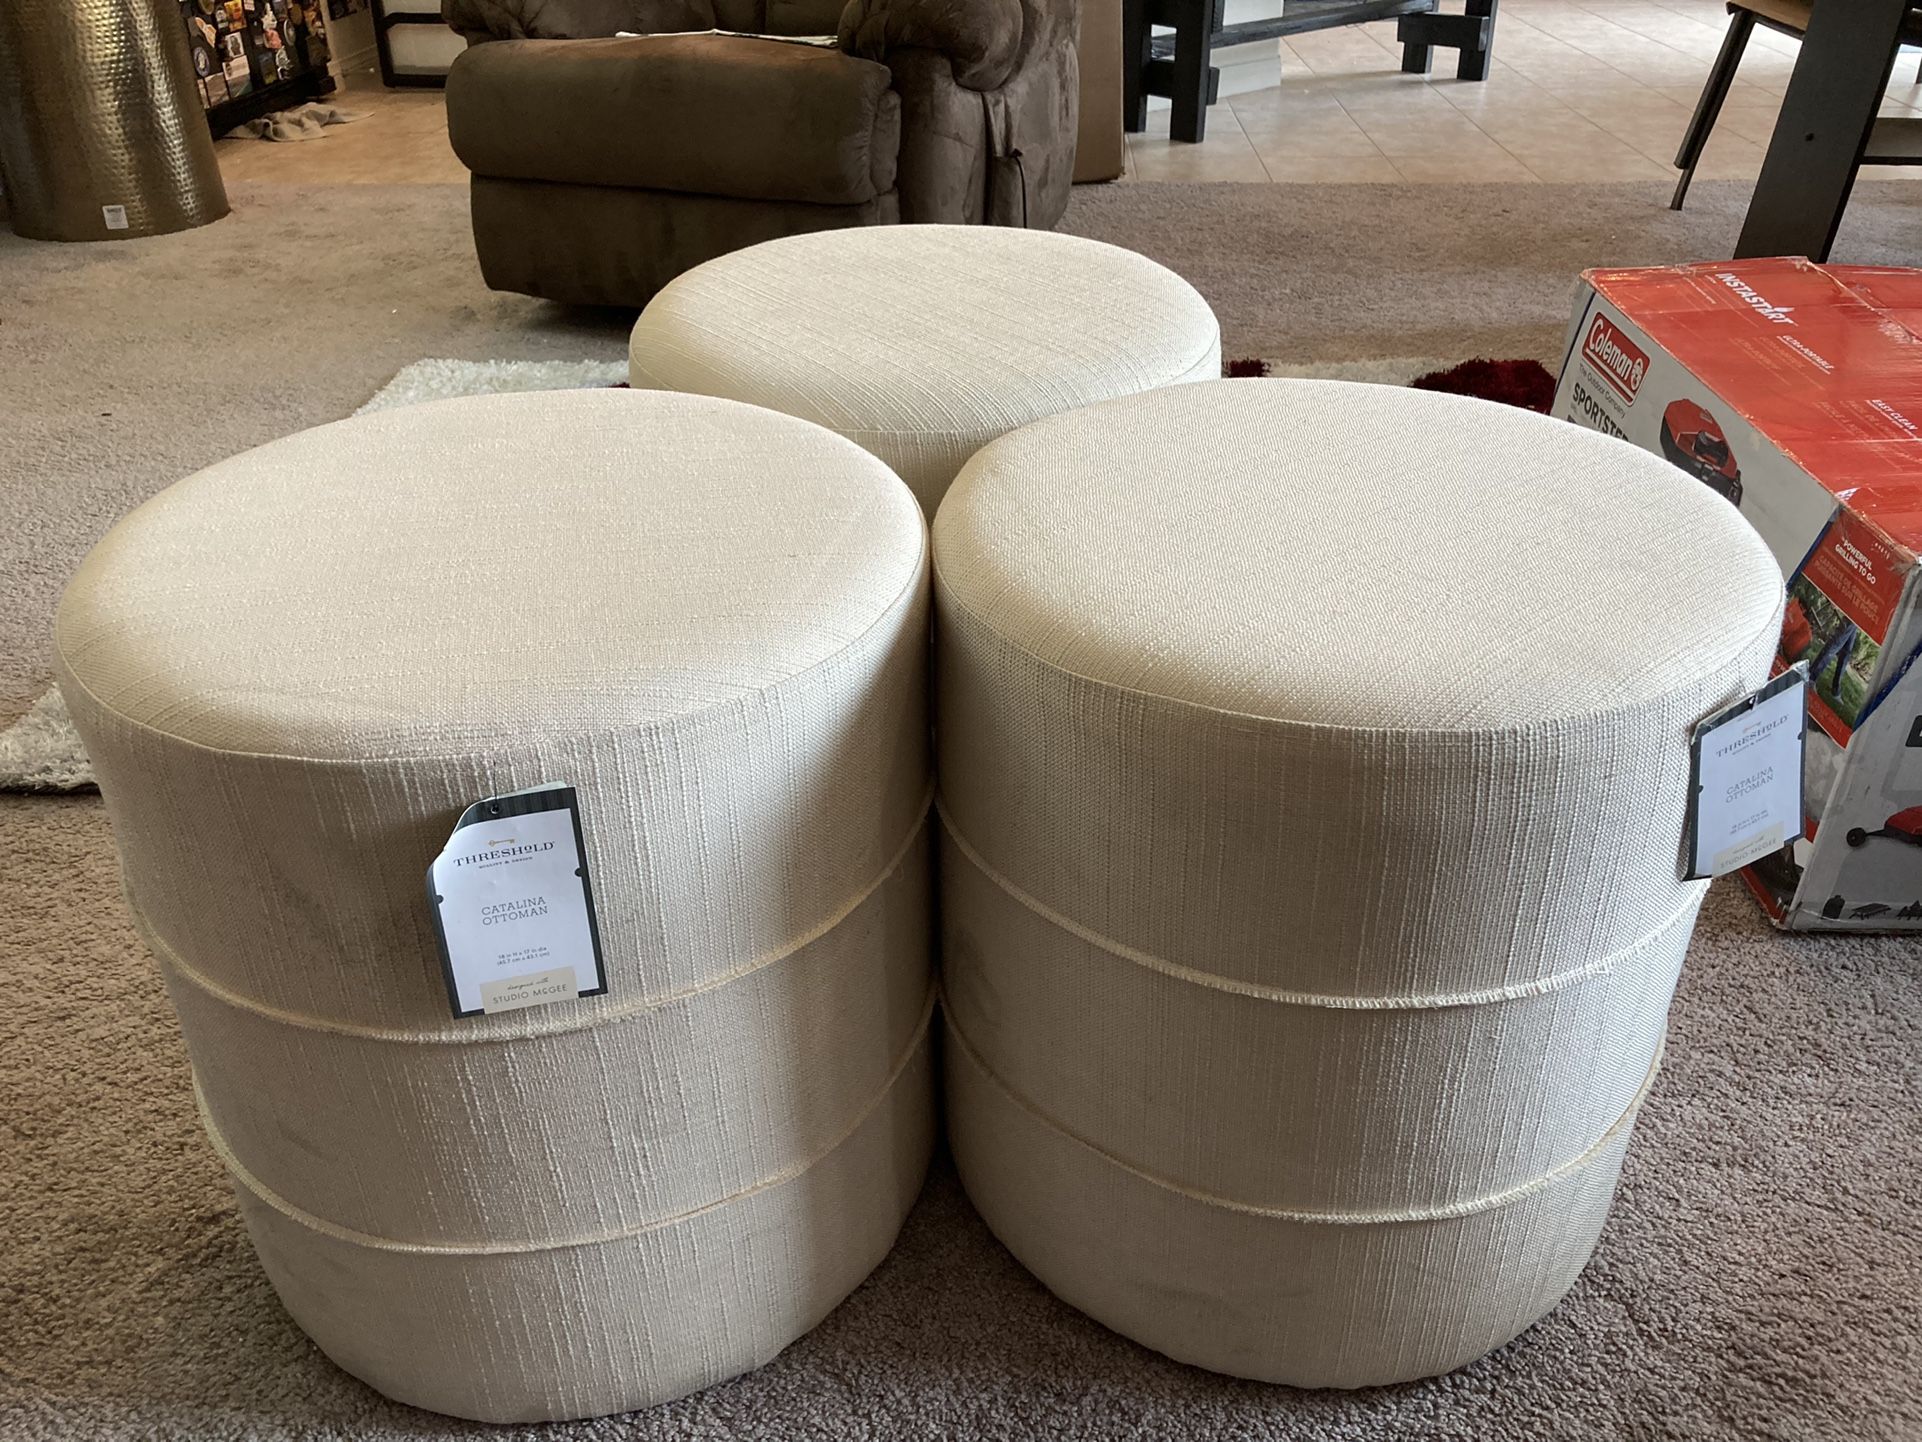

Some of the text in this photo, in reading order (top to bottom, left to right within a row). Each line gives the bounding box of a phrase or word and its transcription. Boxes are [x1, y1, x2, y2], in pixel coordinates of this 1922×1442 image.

[1715, 272, 1796, 325] INSTASTART
[1588, 318, 1633, 381] Coleman
[1604, 391, 1626, 419] Company
[1890, 411, 1918, 431] CLEAN
[1835, 544, 1859, 569] GRILLING
[1866, 572, 1876, 585] GO
[1843, 539, 1873, 571] POWERFUL
[1725, 774, 1774, 803] OTTOMAN
[1726, 766, 1774, 795] CATALINA
[481, 896, 546, 916] CATALINA
[482, 906, 548, 926] OTTOMAN
[493, 991, 529, 1004] STUDIO
